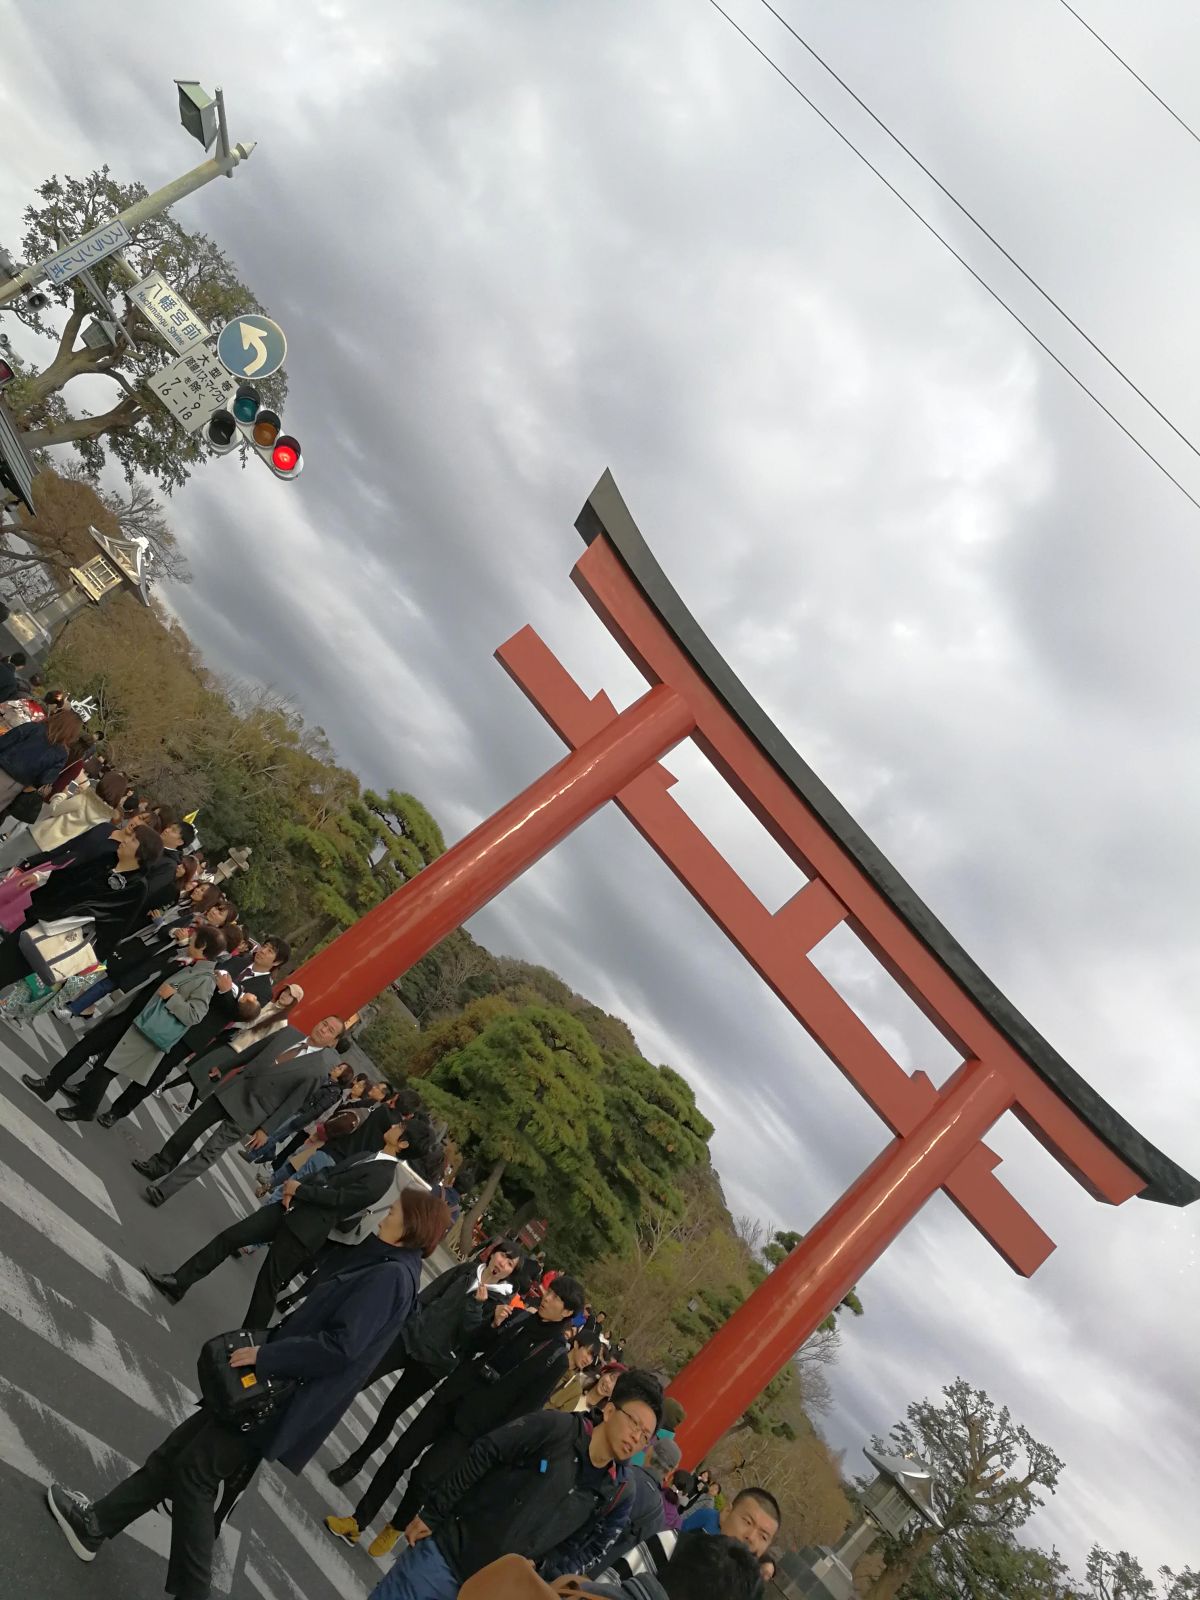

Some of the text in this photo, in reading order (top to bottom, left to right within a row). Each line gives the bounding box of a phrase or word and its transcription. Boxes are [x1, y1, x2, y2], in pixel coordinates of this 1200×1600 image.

[137, 291, 184, 346] Hachimangu Shrine
[145, 283, 201, 340] 八幡宮前
[197, 354, 233, 392] 大型等
